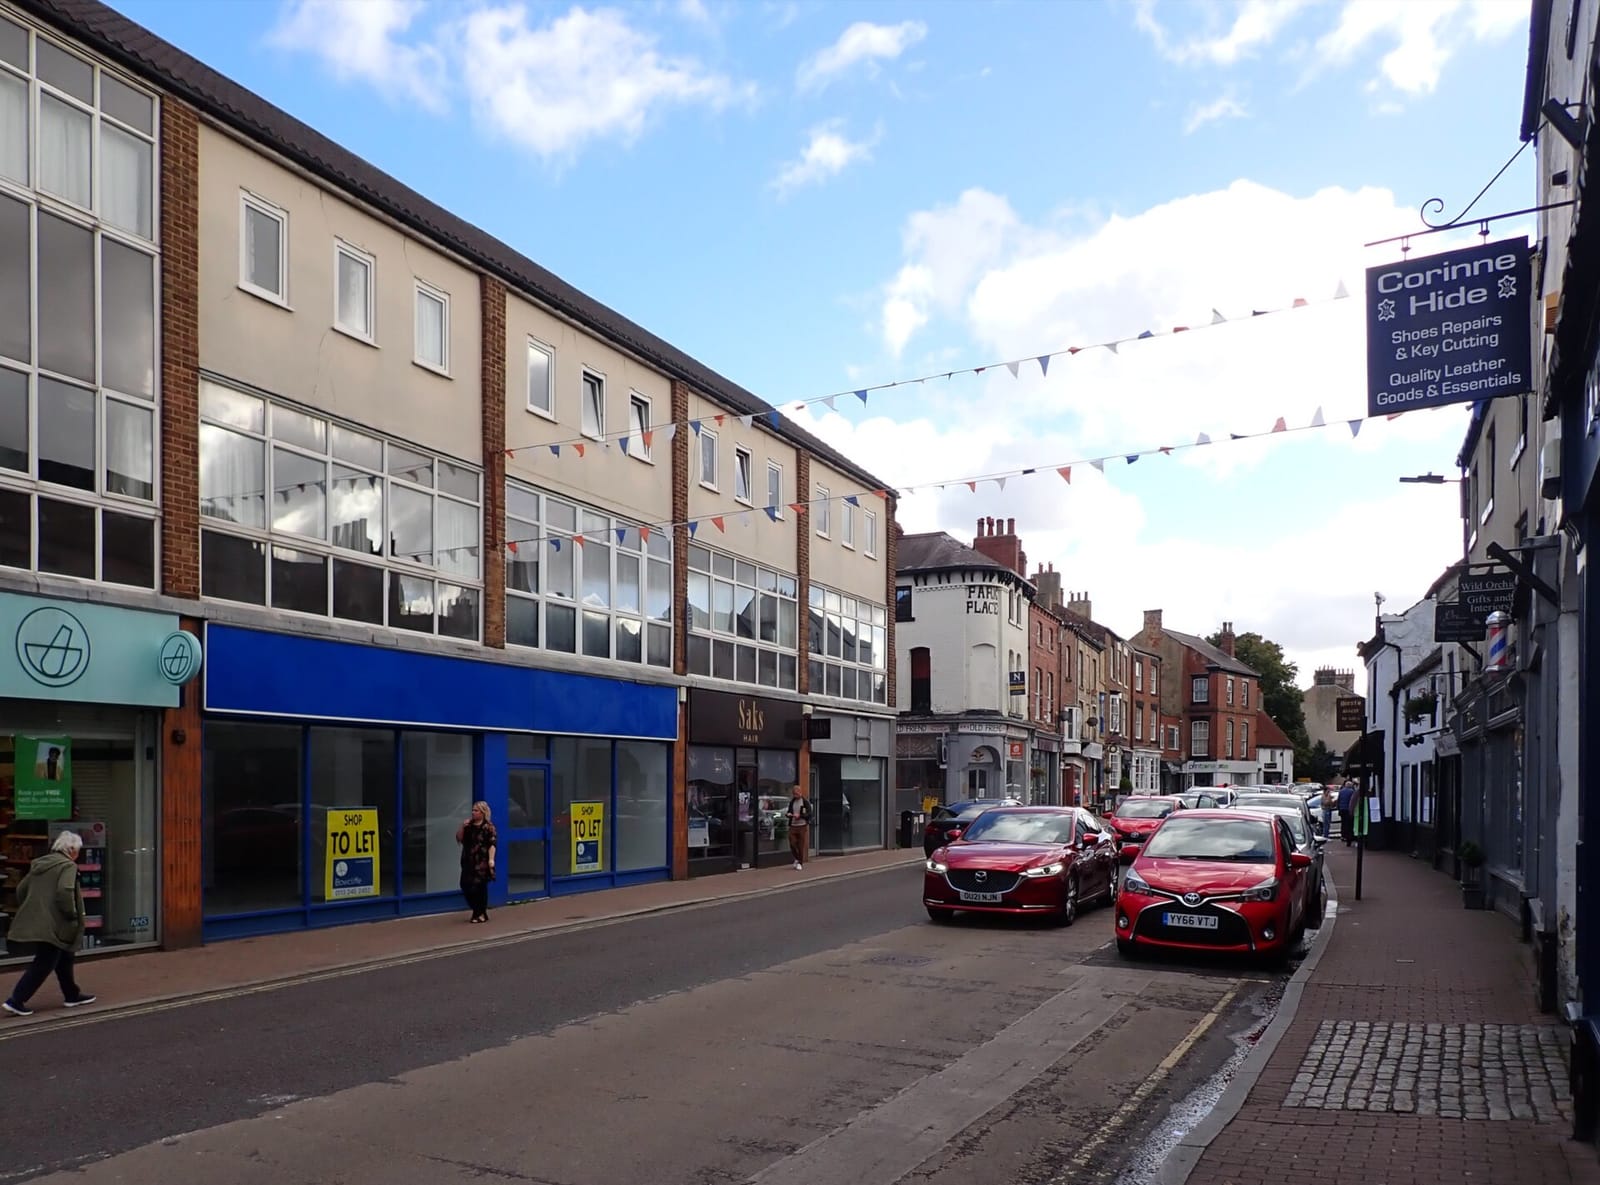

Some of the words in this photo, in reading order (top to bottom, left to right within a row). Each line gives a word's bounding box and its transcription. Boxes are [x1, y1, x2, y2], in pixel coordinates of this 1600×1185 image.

[1378, 254, 1516, 293] Corinne
[1410, 286, 1487, 315] Hide
[1391, 327, 1438, 344] Shoes
[1441, 315, 1502, 335] Repairs
[1395, 347, 1408, 360] &
[1411, 344, 1439, 358] Key
[1442, 334, 1499, 352] Cutting
[1389, 368, 1441, 386] Quality
[1444, 358, 1506, 377] Leather
[1376, 388, 1424, 405] Goods
[1426, 384, 1439, 397] &
[1442, 371, 1521, 395] Essentials
[968, 585, 998, 600] PARK
[1461, 582, 1483, 591] Wild
[1467, 594, 1491, 604] Gifts
[966, 601, 999, 615] PLACE
[739, 699, 764, 730] Saks
[743, 734, 759, 743] HAIR
[582, 807, 594, 815] SHOP
[344, 814, 362, 826] SHOP
[573, 820, 586, 838] TO
[588, 819, 602, 837] LET
[331, 830, 350, 855] TO
[355, 830, 375, 853] LET
[131, 918, 148, 928] NHS
[1170, 914, 1195, 925] YY66
[1197, 916, 1217, 927] VTJ
